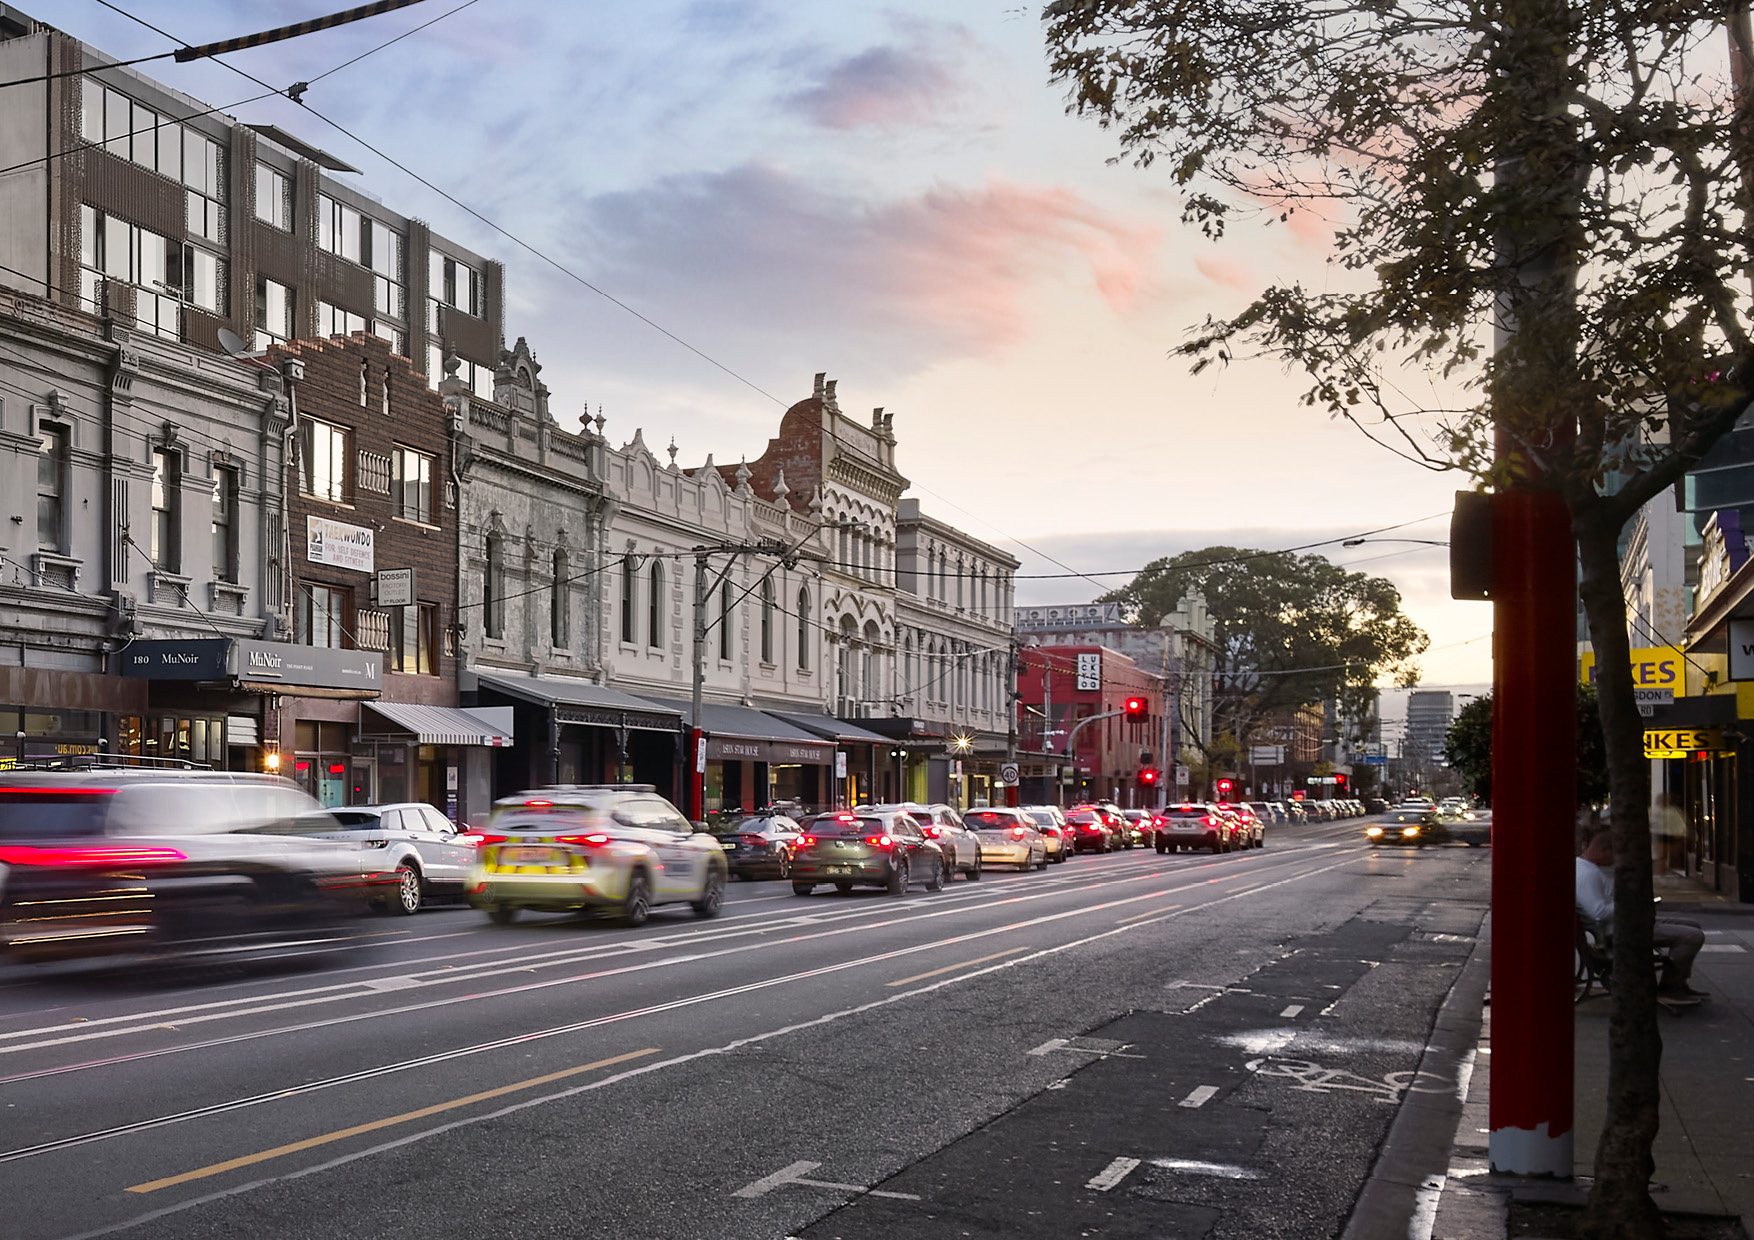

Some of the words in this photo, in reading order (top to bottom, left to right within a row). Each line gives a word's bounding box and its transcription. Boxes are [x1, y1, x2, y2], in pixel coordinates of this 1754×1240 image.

[325, 542, 336, 552] FOR
[338, 545, 349, 554] SELF
[350, 547, 371, 560] DEFENCE
[333, 554, 343, 563] AND
[344, 556, 364, 568] FITNESS
[381, 572, 409, 581] bossini
[133, 656, 150, 664] 180
[161, 653, 199, 664] MuNoir
[249, 651, 282, 668] MuNoir
[1641, 705, 1652, 715] RD
[1004, 771, 1014, 780] 40
